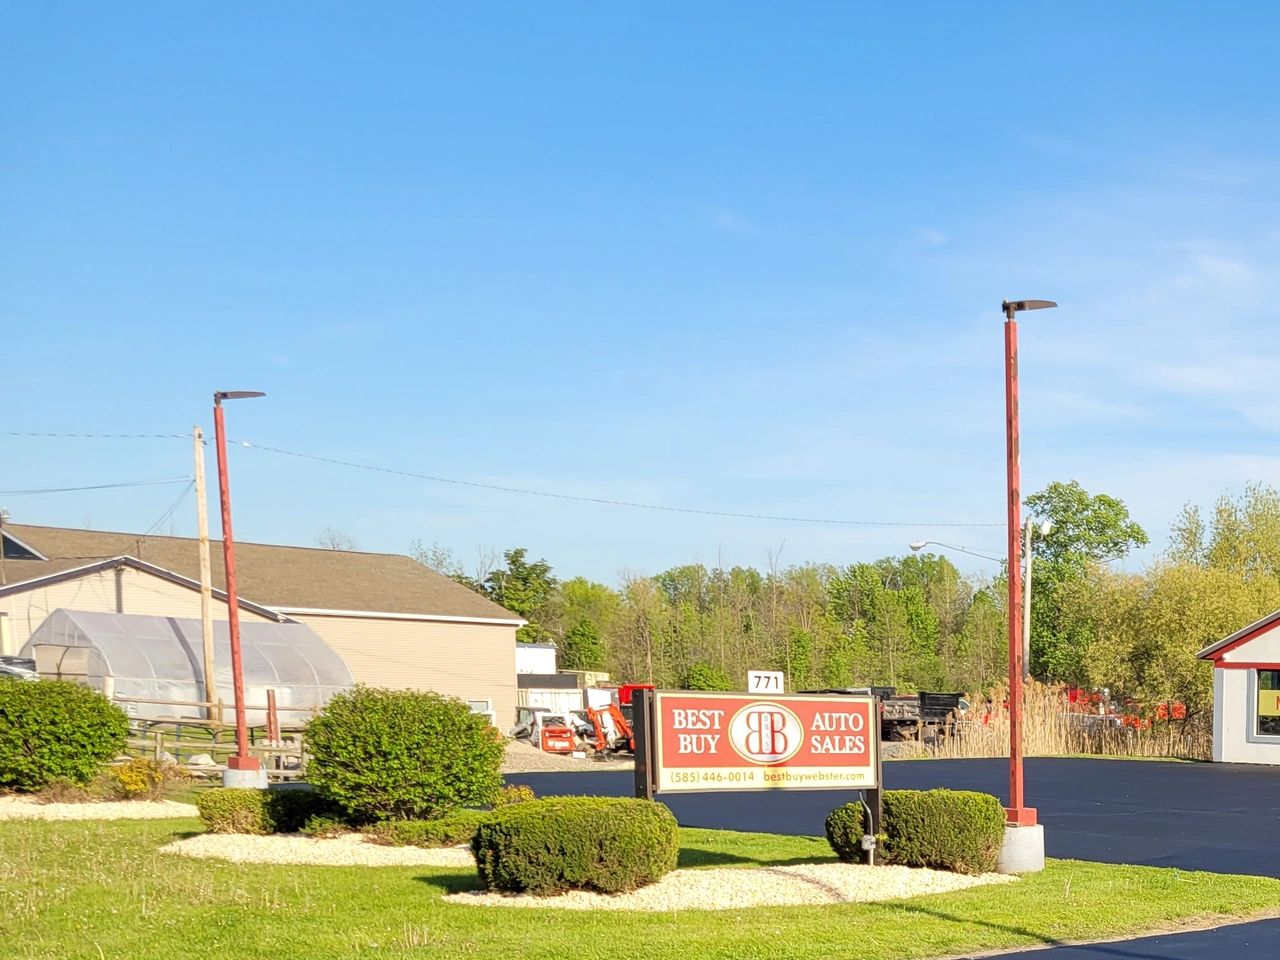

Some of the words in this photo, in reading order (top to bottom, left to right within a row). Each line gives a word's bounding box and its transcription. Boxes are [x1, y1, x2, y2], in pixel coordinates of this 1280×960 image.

[754, 675, 779, 690] 771
[672, 709, 724, 730] BEST
[811, 712, 864, 732] AUTO
[678, 734, 720, 754] BUY
[811, 735, 865, 754] SALES
[670, 772, 700, 783] (585)
[702, 771, 754, 782] 446-0014
[764, 771, 865, 783] bestbuywebster.com
